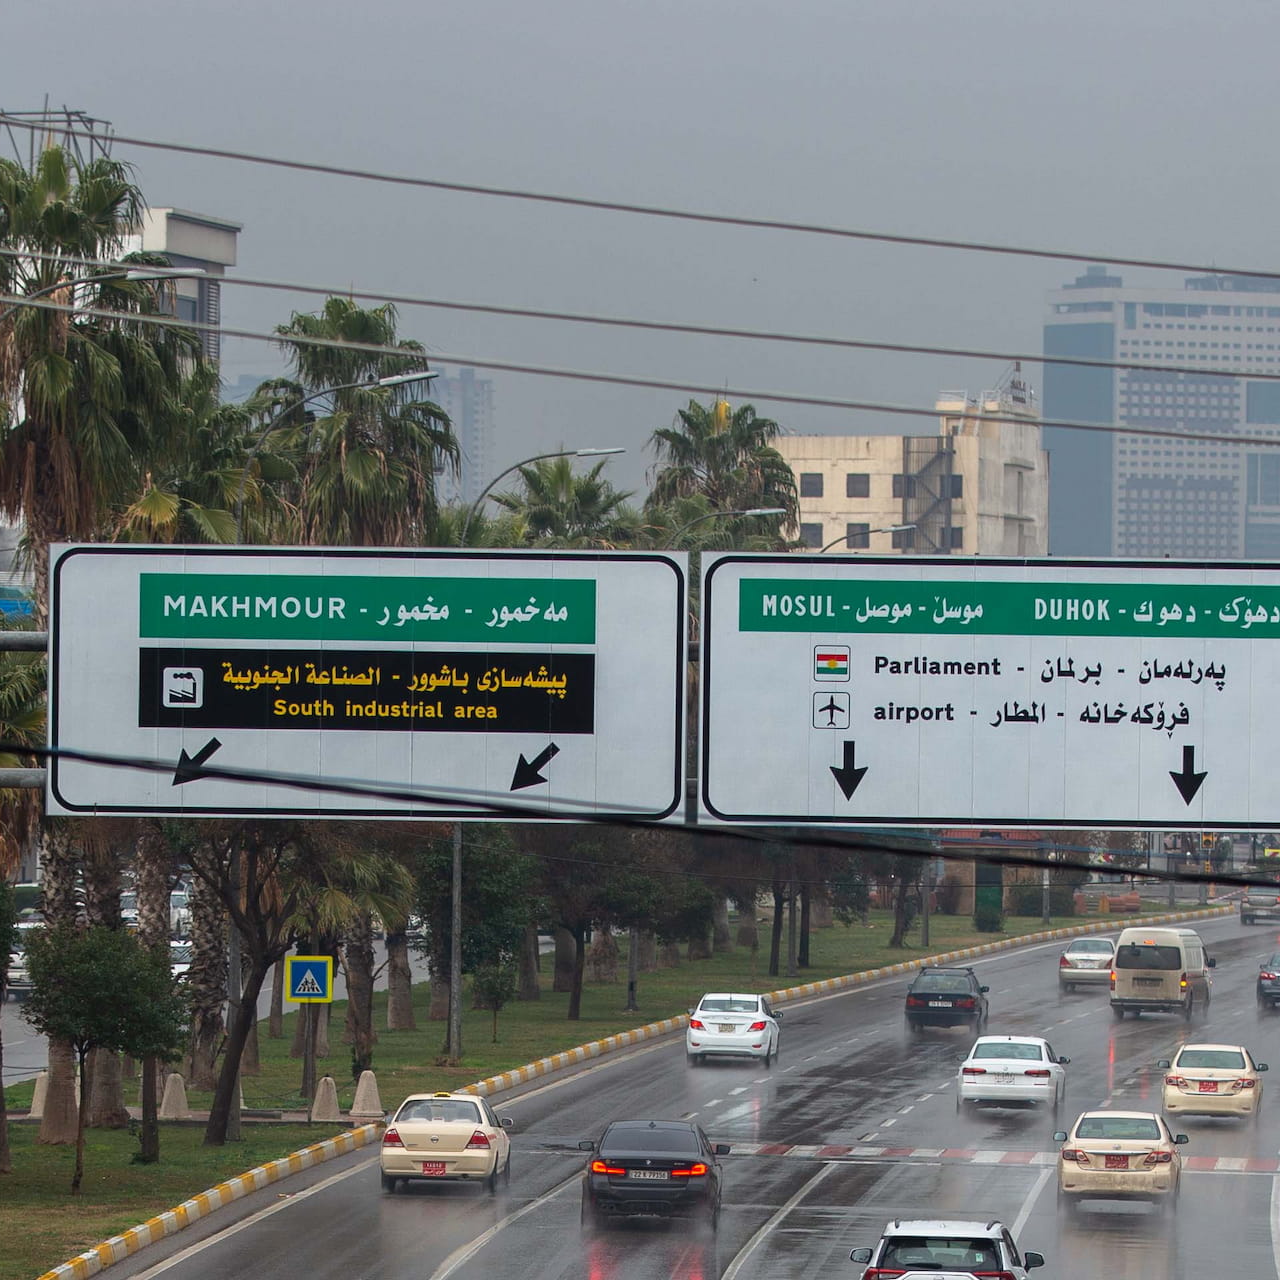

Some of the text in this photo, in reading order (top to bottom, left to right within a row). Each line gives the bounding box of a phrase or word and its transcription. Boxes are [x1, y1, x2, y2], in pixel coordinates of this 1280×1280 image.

[163, 595, 346, 619] MAKHMOUR
[376, 596, 450, 626] مخمور
[762, 594, 835, 617] MOSUL
[855, 596, 913, 624] موصل
[1034, 598, 1111, 621] DUHOK
[221, 661, 300, 691] الجنوبية
[305, 662, 381, 686] الصناعة
[407, 663, 469, 694] باشوور
[873, 656, 1001, 676] Parliament
[1040, 657, 1103, 686] برلمان
[273, 699, 498, 718] South industrial area
[873, 701, 955, 724] airport
[989, 700, 1046, 728] المطار
